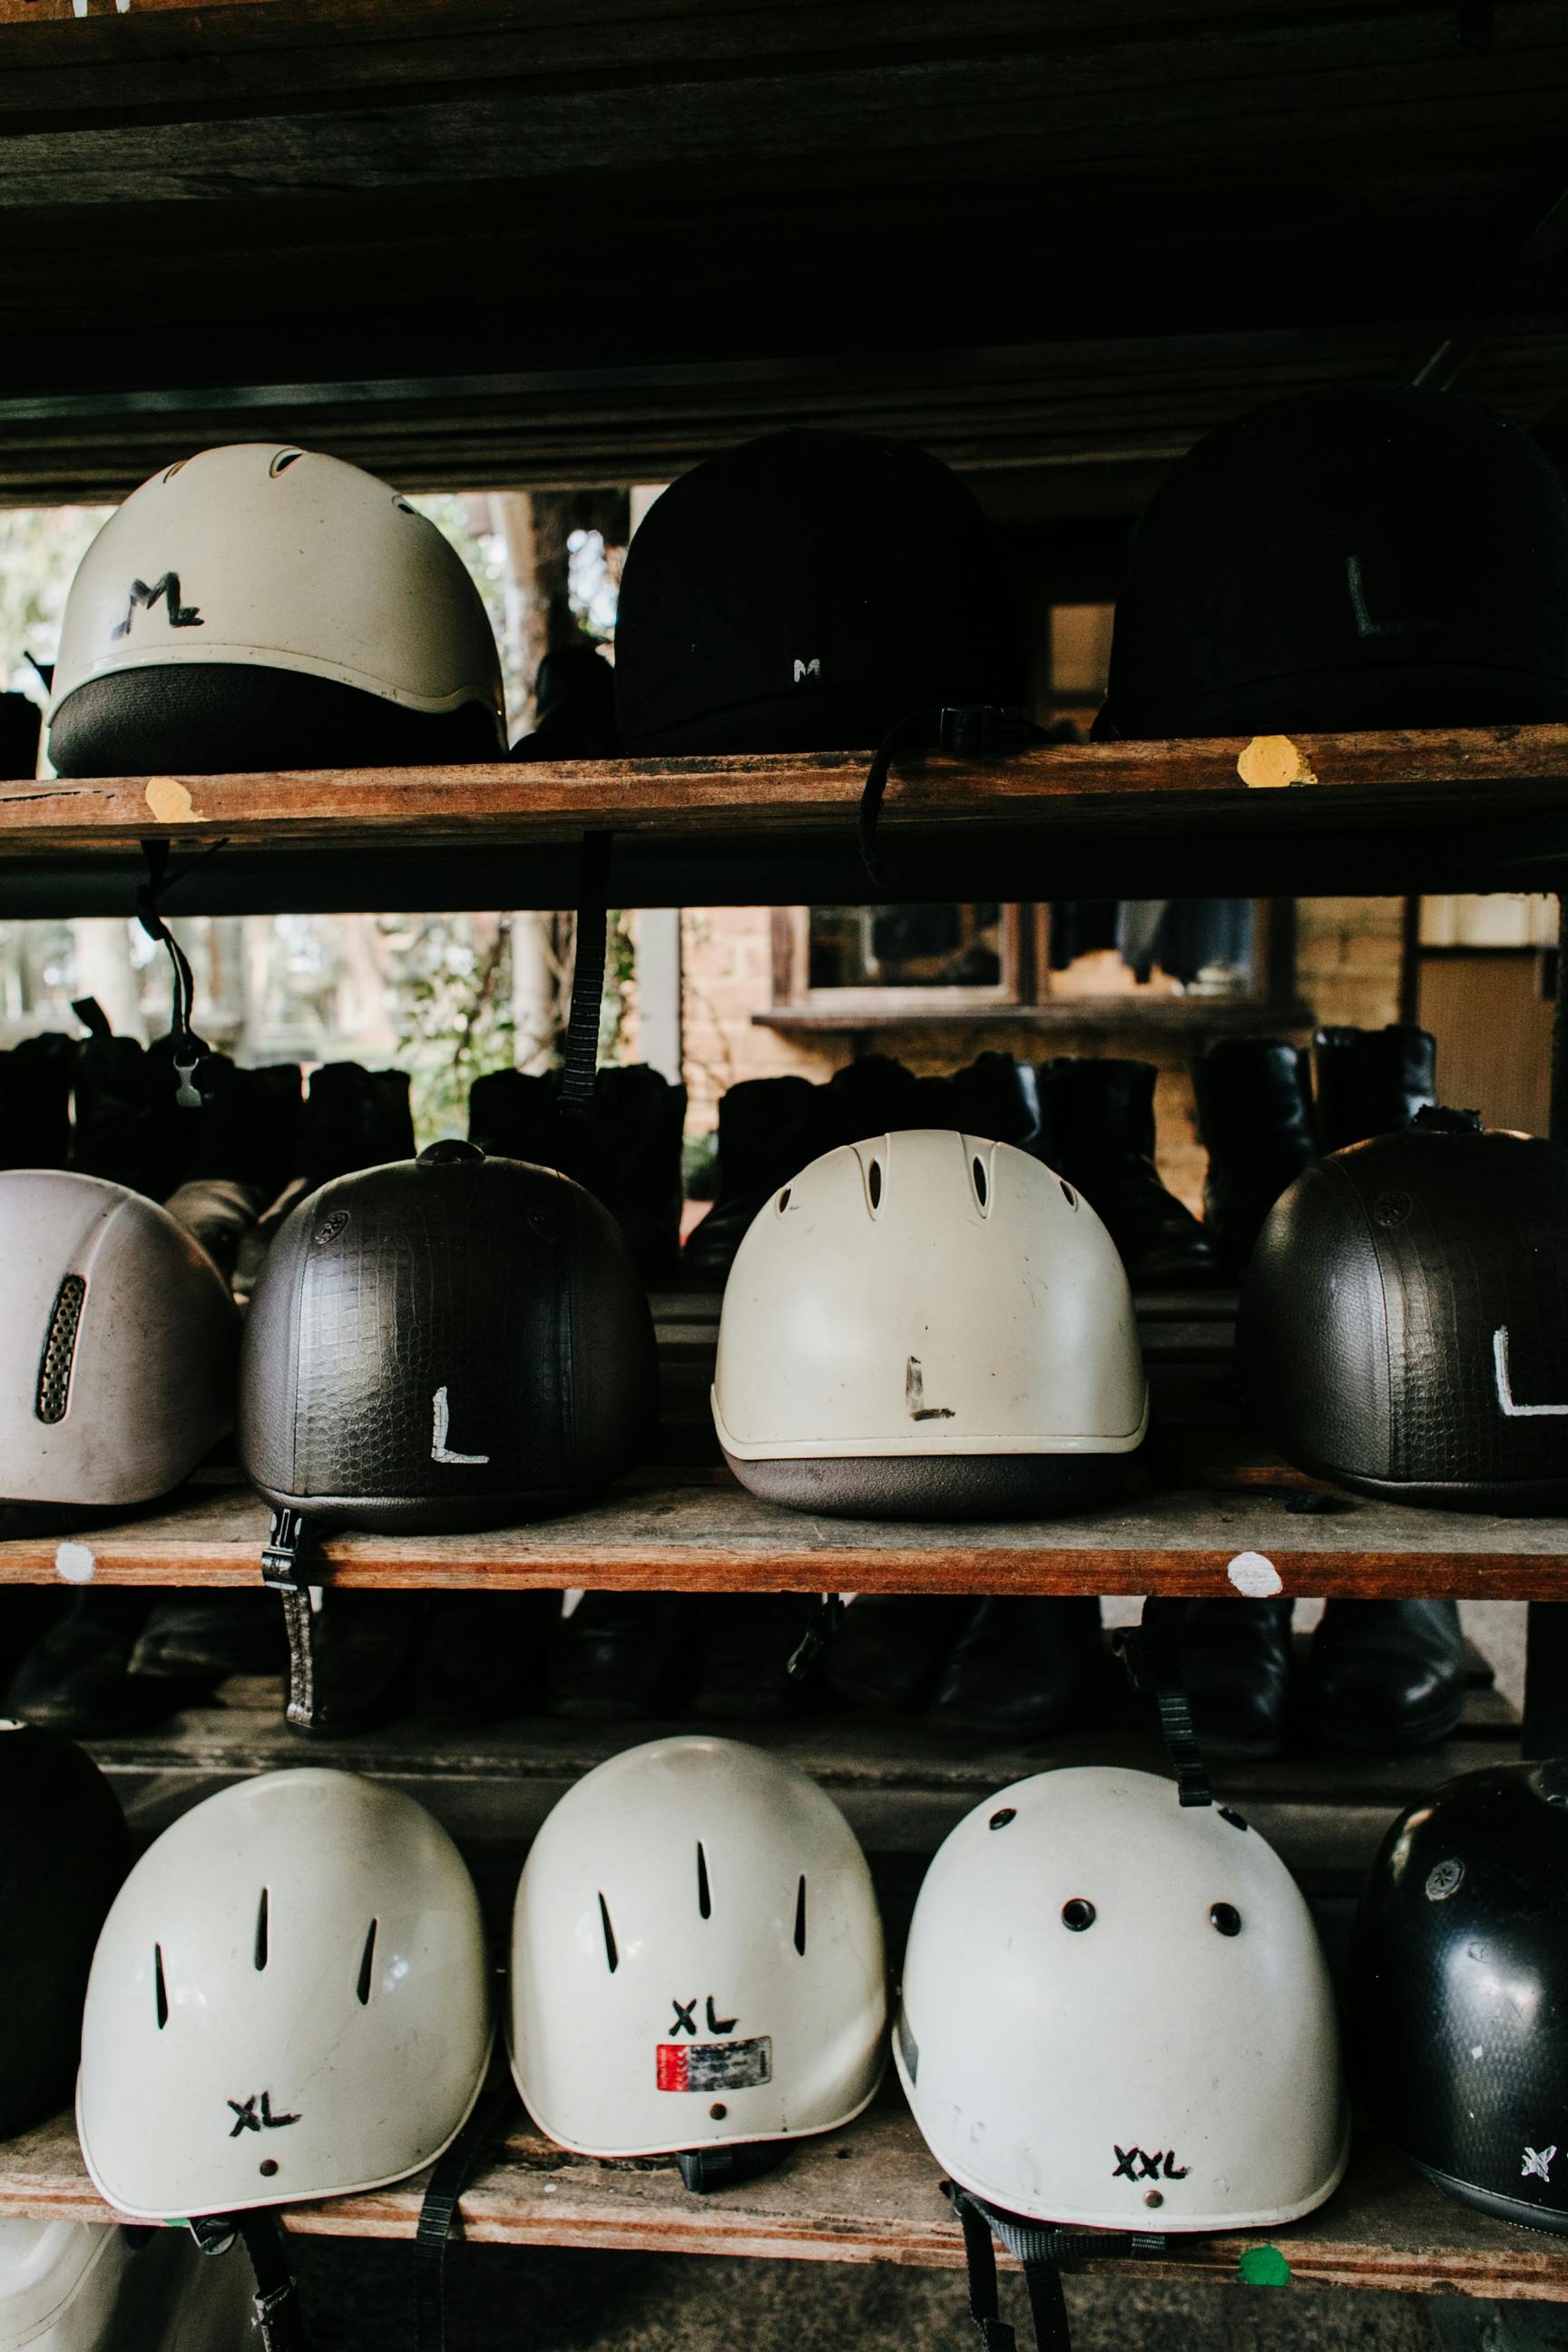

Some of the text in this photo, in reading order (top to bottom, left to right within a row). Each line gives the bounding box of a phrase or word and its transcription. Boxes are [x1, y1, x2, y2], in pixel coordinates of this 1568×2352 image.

[1344, 554, 1412, 638] L
[793, 657, 821, 682] M
[906, 1356, 956, 1421] L
[1493, 1324, 1568, 1416] L
[431, 1385, 490, 1464] L
[669, 1994, 740, 2036] XL
[227, 2090, 302, 2137] XL
[1112, 2144, 1191, 2181] XXL
